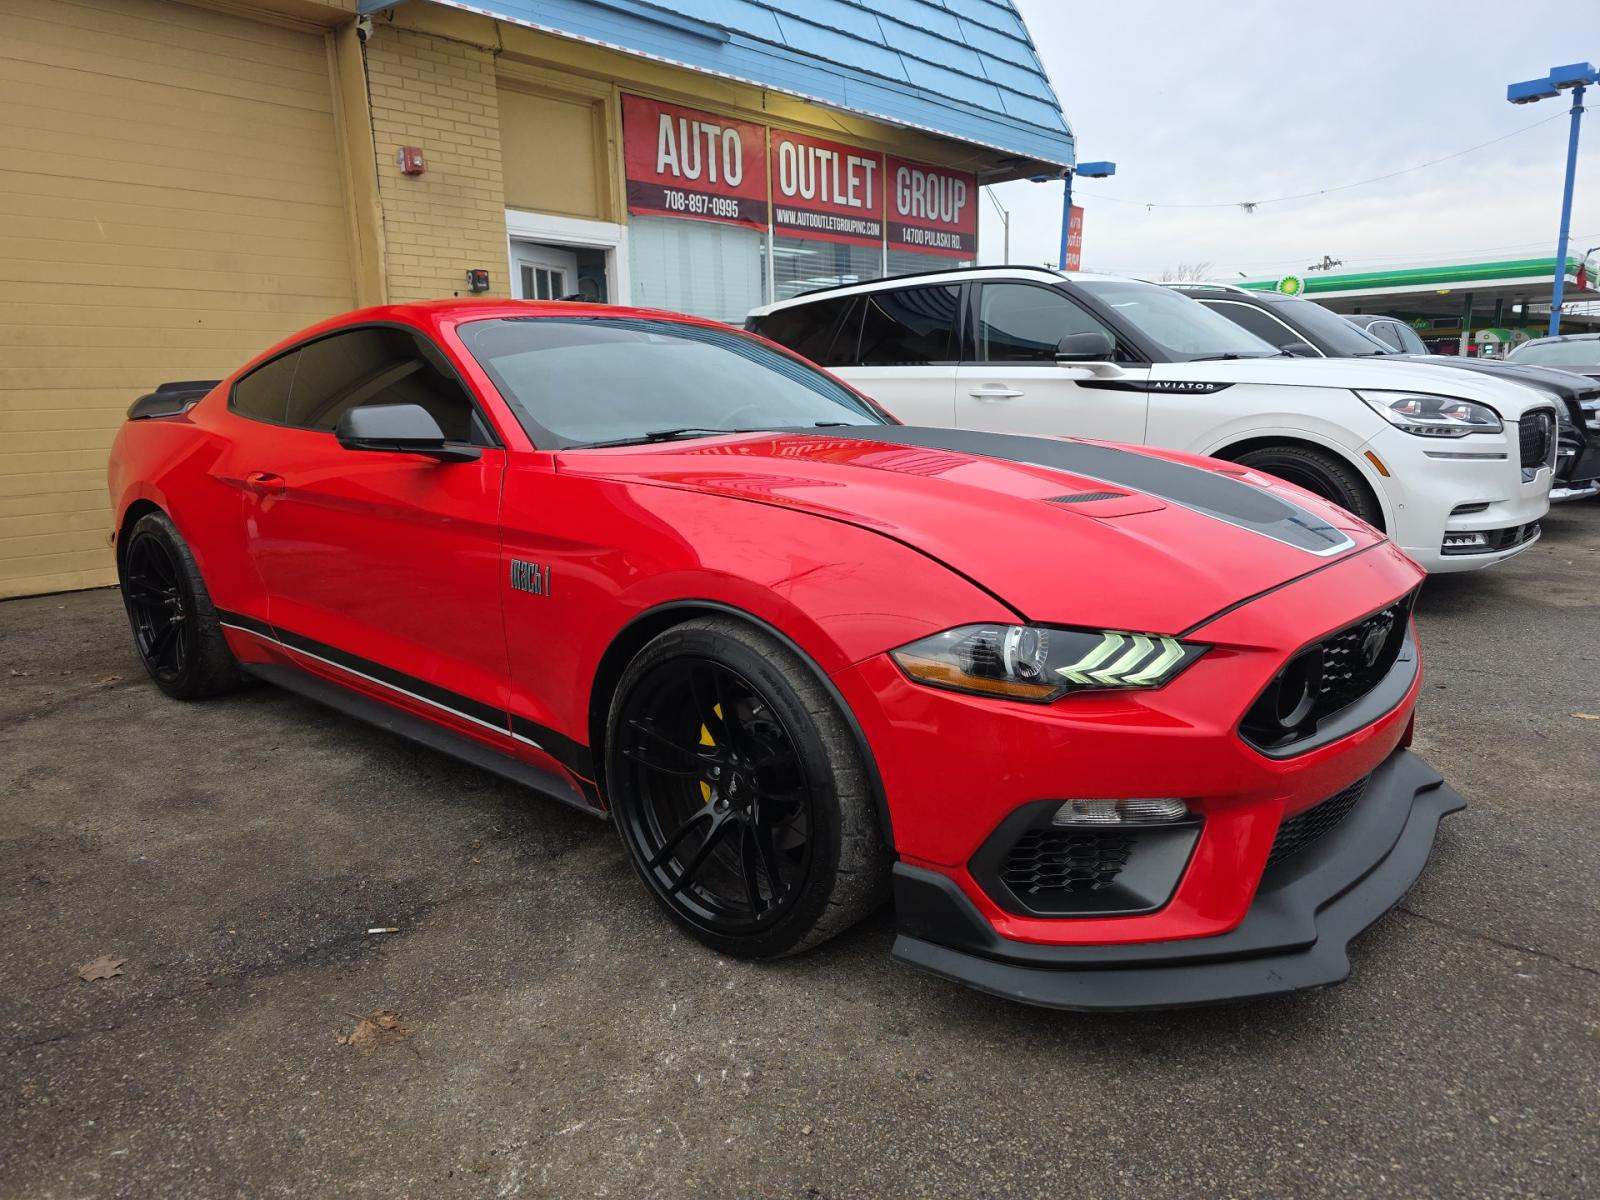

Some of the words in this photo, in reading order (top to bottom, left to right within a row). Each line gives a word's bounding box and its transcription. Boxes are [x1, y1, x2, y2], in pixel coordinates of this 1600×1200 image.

[656, 113, 743, 187] AUTO
[779, 141, 877, 209] OUTLET
[663, 189, 739, 218] 708-897-0995
[896, 167, 966, 224] GROUP
[776, 208, 880, 236] WWW.AUTOOUTLETGROUPINC.COM
[902, 227, 924, 245] 14700
[924, 230, 951, 248] PULASKI
[1155, 382, 1214, 390] AVIATOR
